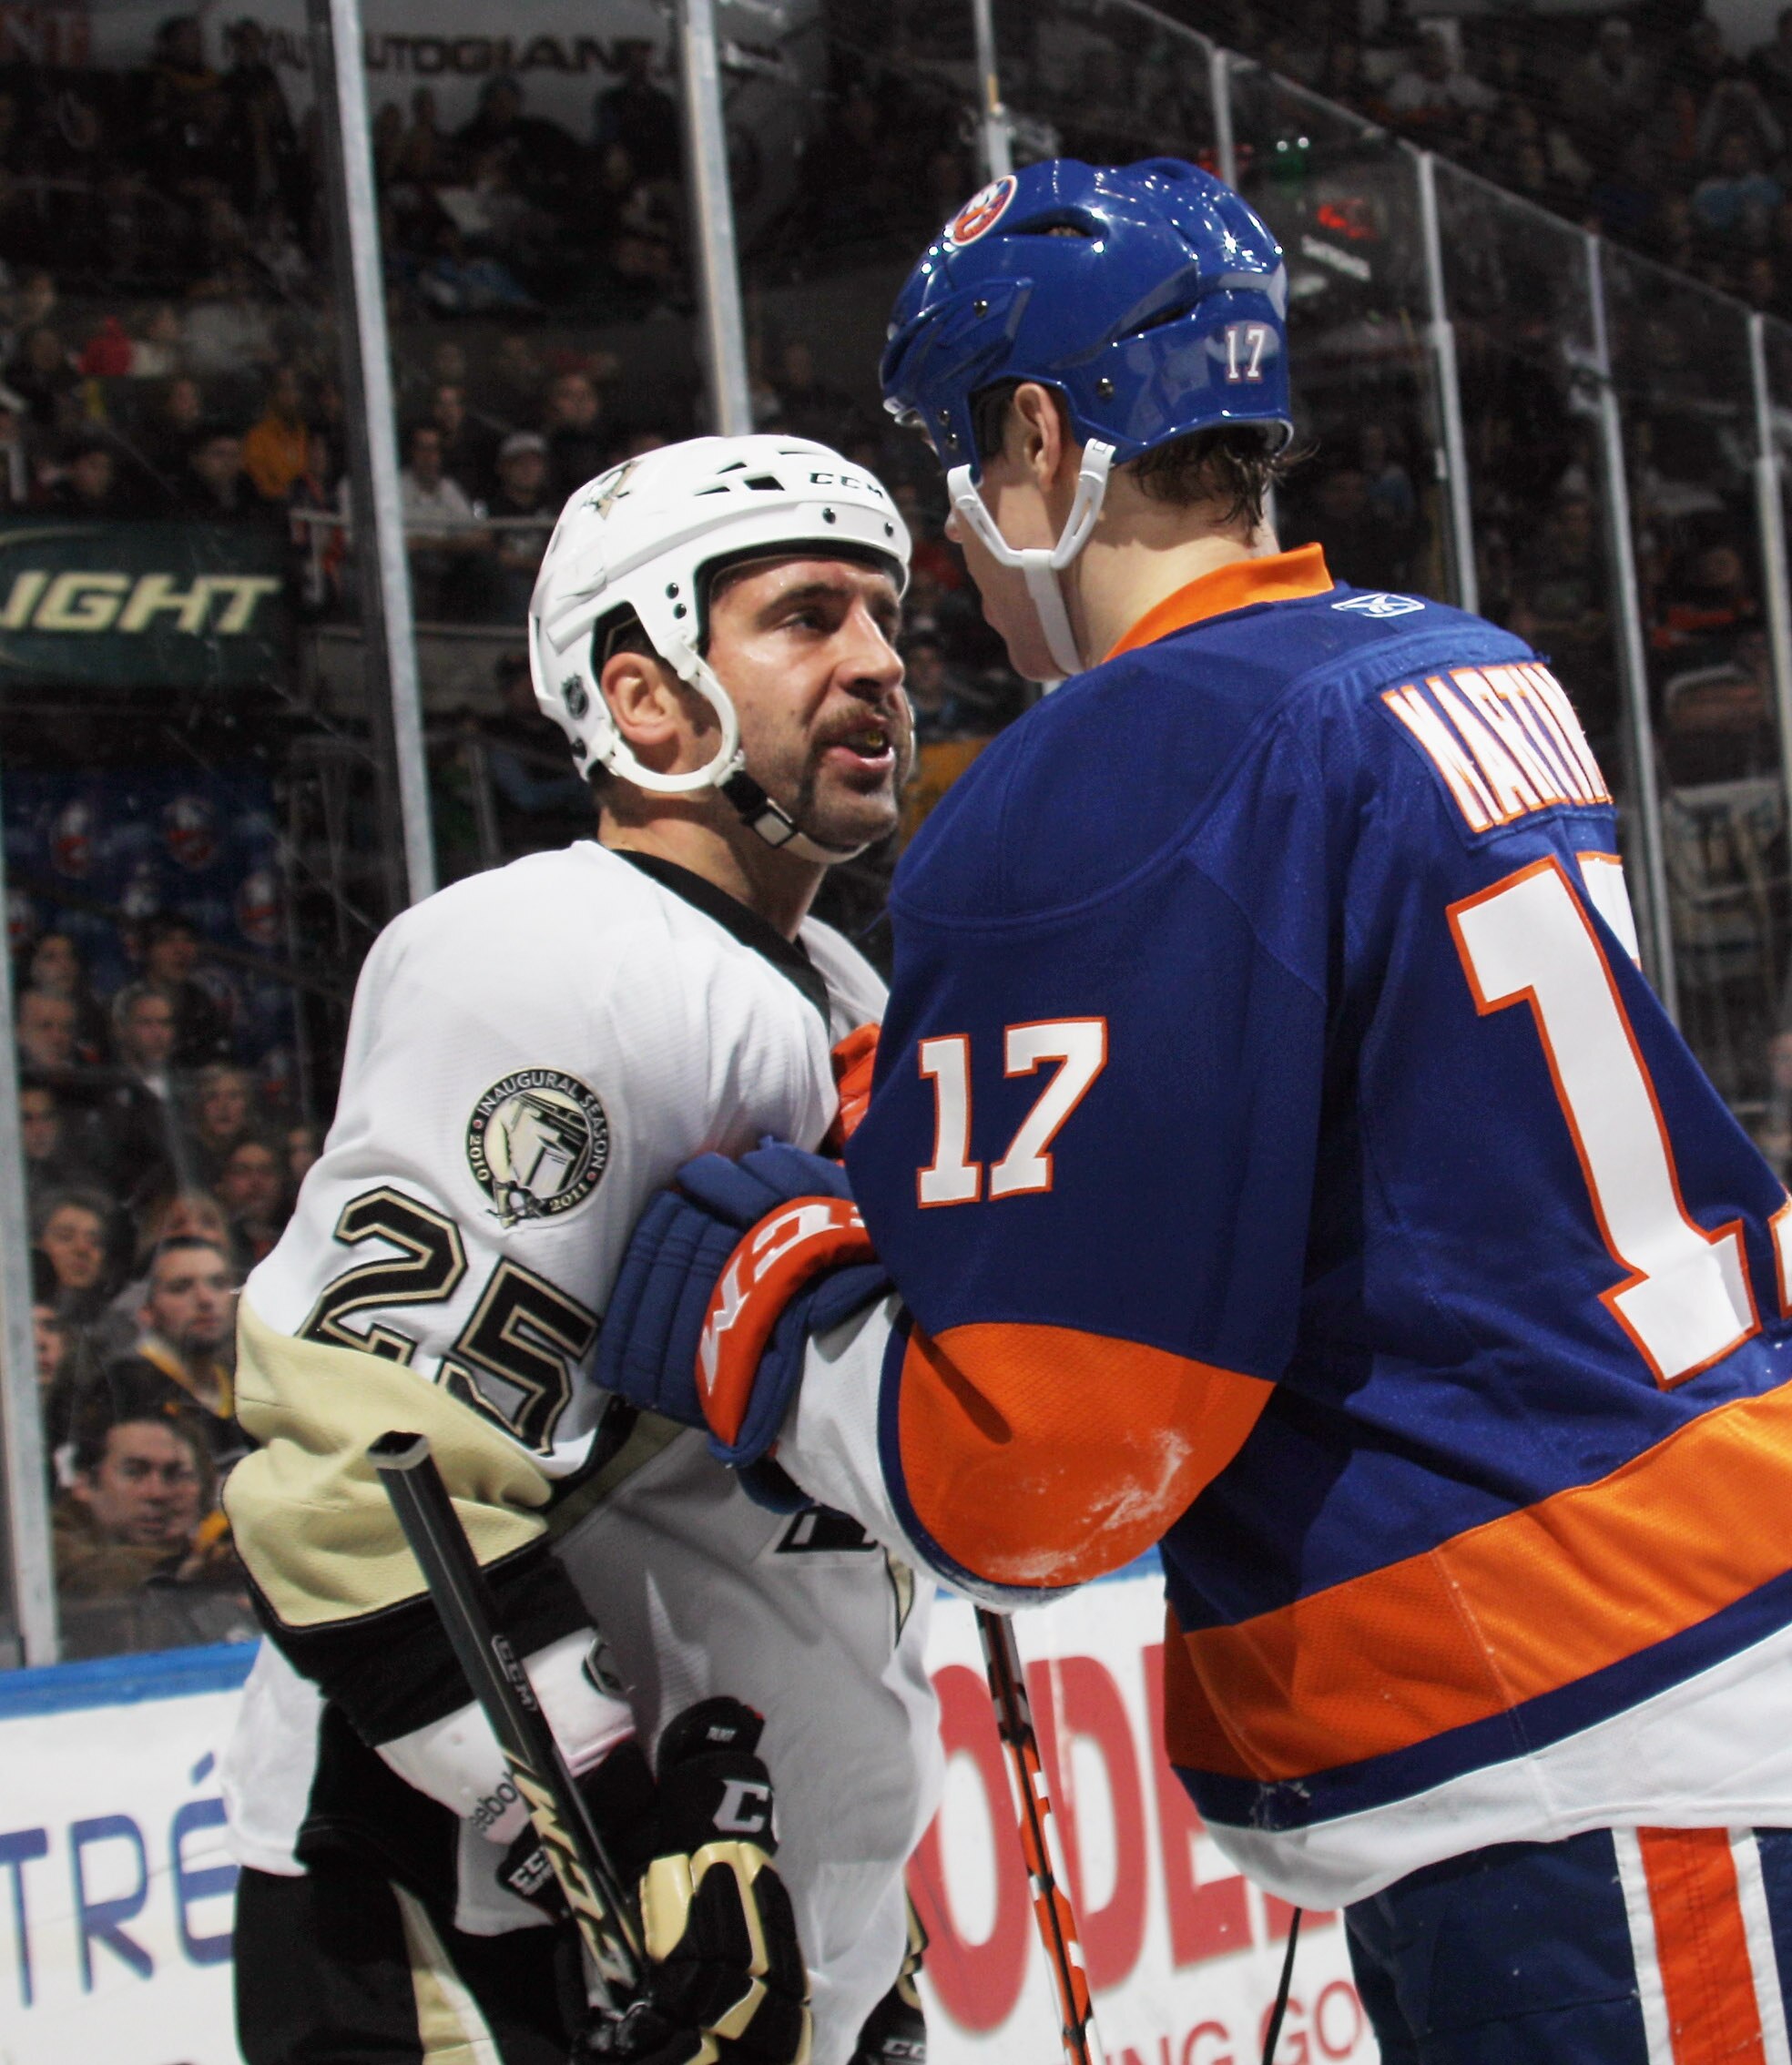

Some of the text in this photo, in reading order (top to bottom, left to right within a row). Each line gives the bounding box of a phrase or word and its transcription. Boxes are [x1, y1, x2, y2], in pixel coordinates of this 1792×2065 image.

[1224, 325, 1268, 383] 17
[0, 570, 280, 634] IGHT
[476, 1071, 609, 1170] INAUGURAL SEASON
[917, 1016, 1108, 1209] 17
[469, 1134, 491, 1182] 2010
[549, 1183, 589, 1213] 2011
[293, 1185, 601, 1457] 25
[468, 1770, 518, 1832] eebo
